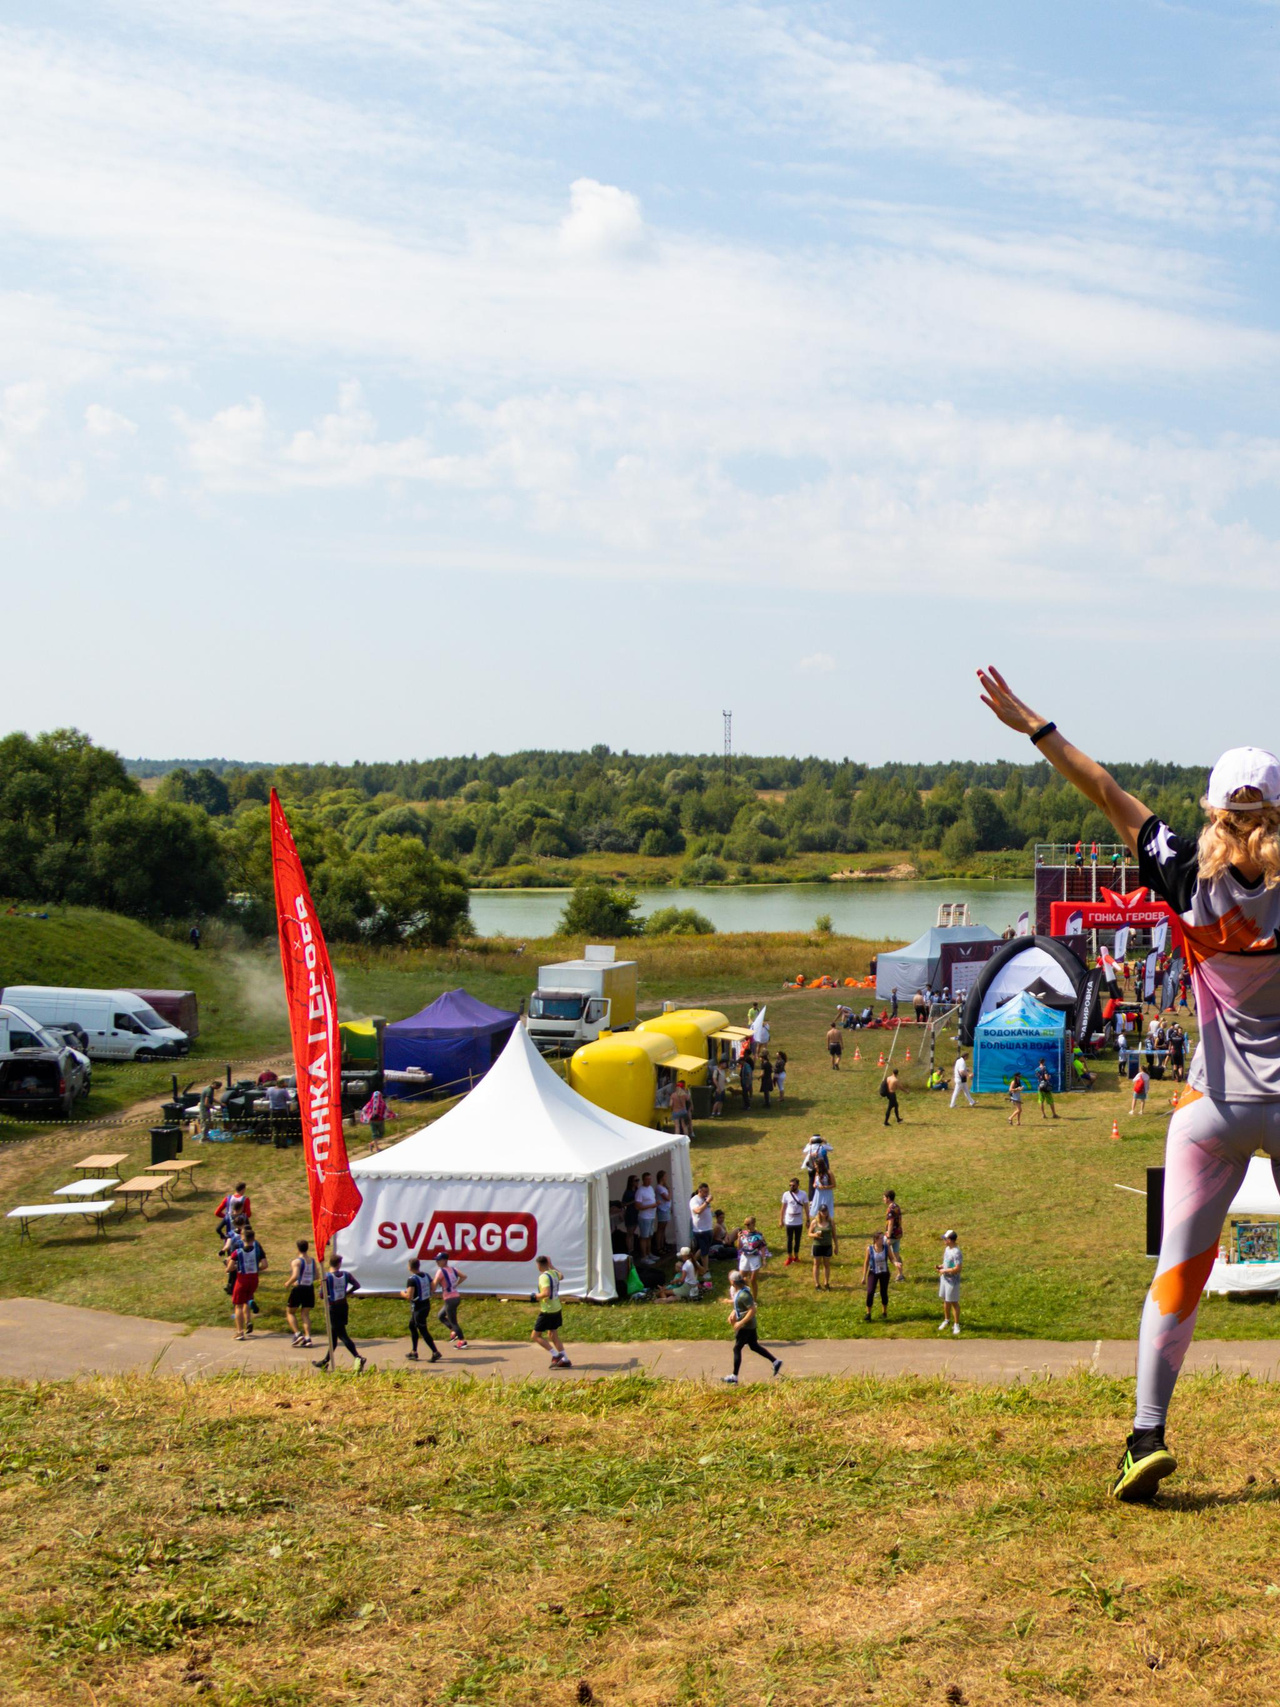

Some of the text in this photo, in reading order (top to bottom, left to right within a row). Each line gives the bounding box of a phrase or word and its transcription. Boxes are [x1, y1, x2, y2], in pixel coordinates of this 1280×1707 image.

[1088, 911, 1165, 922] ГОНКА ГЕРОЕВ
[1080, 980, 1094, 1040] РАВИРОВКА
[980, 1041, 1028, 1050] БОЛЬШАЯ
[376, 1221, 529, 1253] SVARGO
